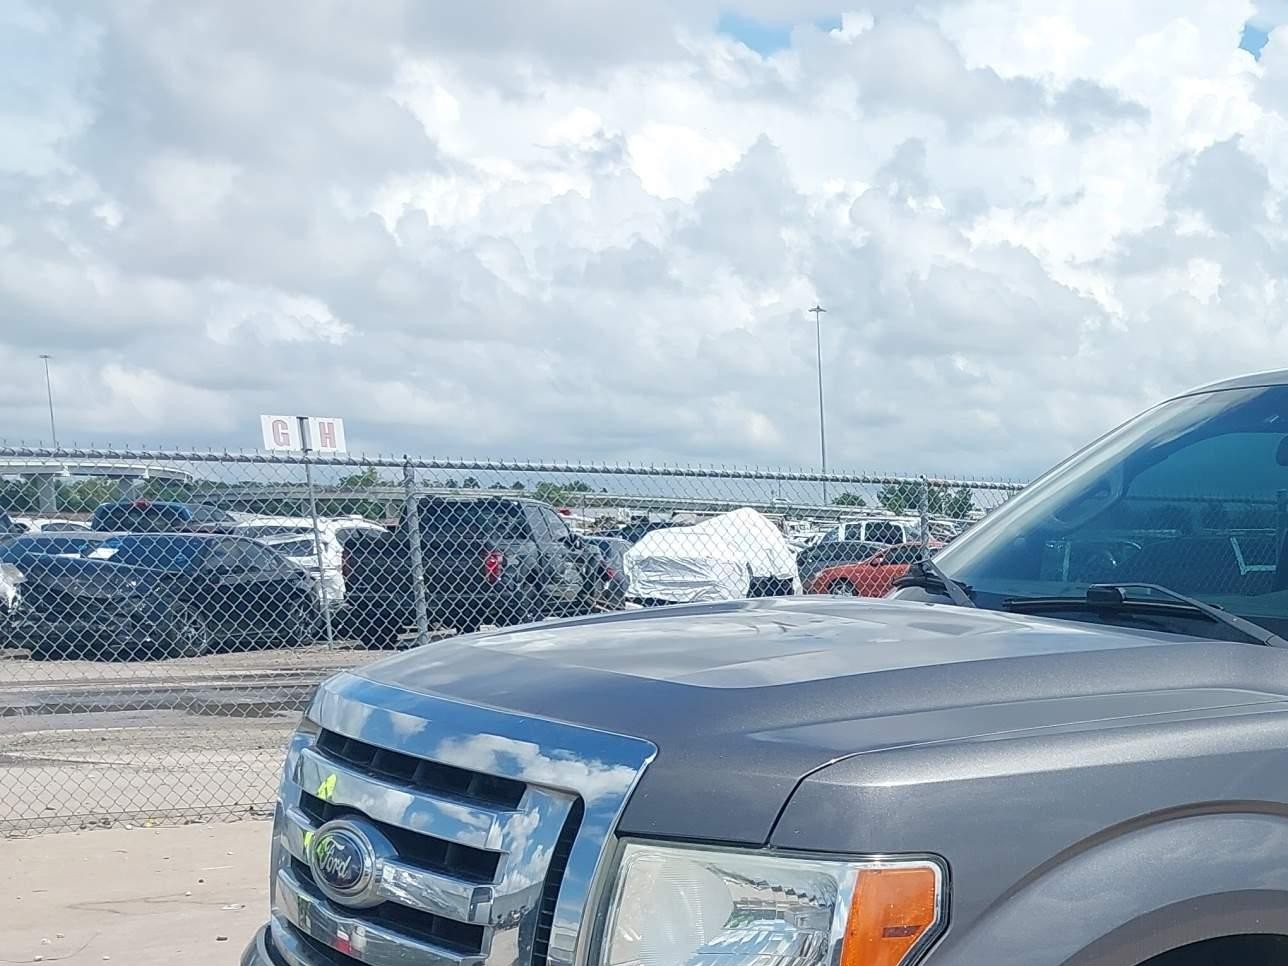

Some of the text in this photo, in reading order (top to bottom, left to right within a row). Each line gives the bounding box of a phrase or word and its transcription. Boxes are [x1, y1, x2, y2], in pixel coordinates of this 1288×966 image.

[271, 419, 290, 447] G
[318, 421, 337, 449] H
[316, 838, 352, 879] Ford
